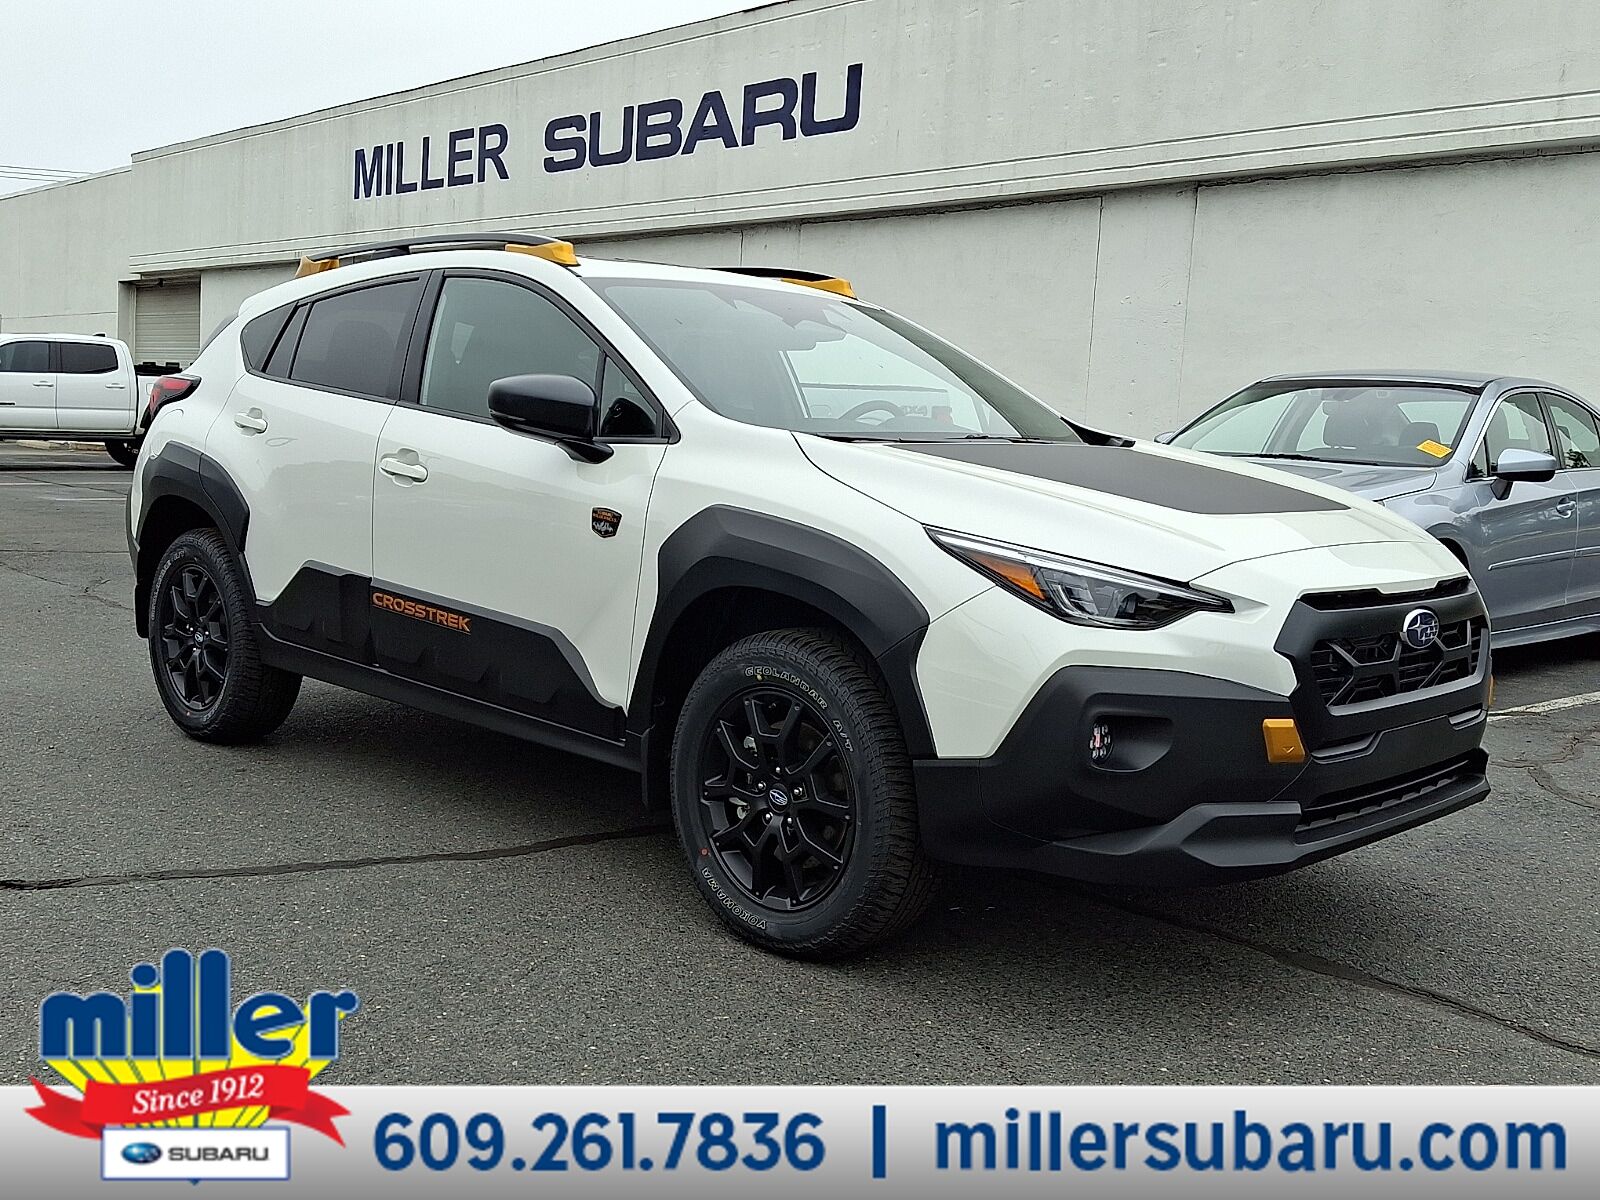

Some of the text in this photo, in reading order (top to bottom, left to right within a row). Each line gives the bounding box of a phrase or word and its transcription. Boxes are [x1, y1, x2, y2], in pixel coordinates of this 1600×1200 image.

[353, 63, 864, 200] MILLER SUBARU
[372, 592, 471, 633] CROSSTREK
[744, 665, 855, 753] GEOLANDAR A/T
[701, 867, 768, 931] YOKOHAMA
